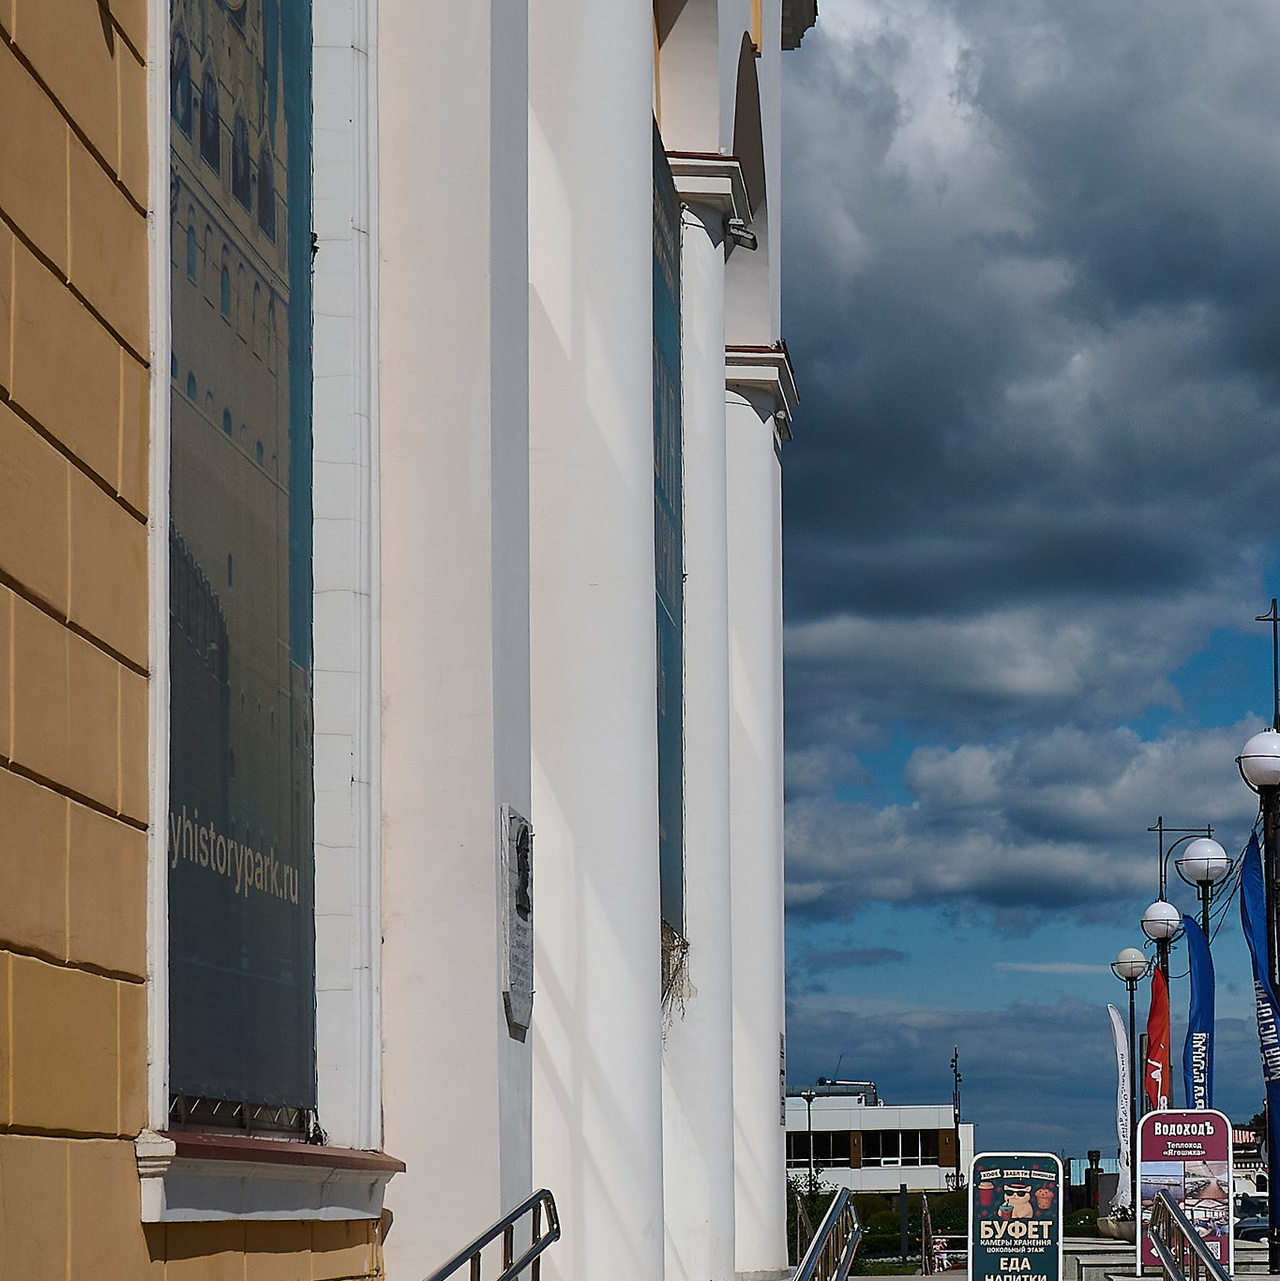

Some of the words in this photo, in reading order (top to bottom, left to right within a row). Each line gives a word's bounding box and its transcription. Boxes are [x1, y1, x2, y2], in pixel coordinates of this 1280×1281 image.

[168, 805, 298, 914] yhistorypark.ru
[1233, 1129, 1256, 1144] ЦИЯ
[980, 1221, 1052, 1239] БУФЕТ
[986, 1246, 1026, 1254] ЦОКОЛЬНЫЙ
[1000, 1258, 1031, 1272] ЕДА
